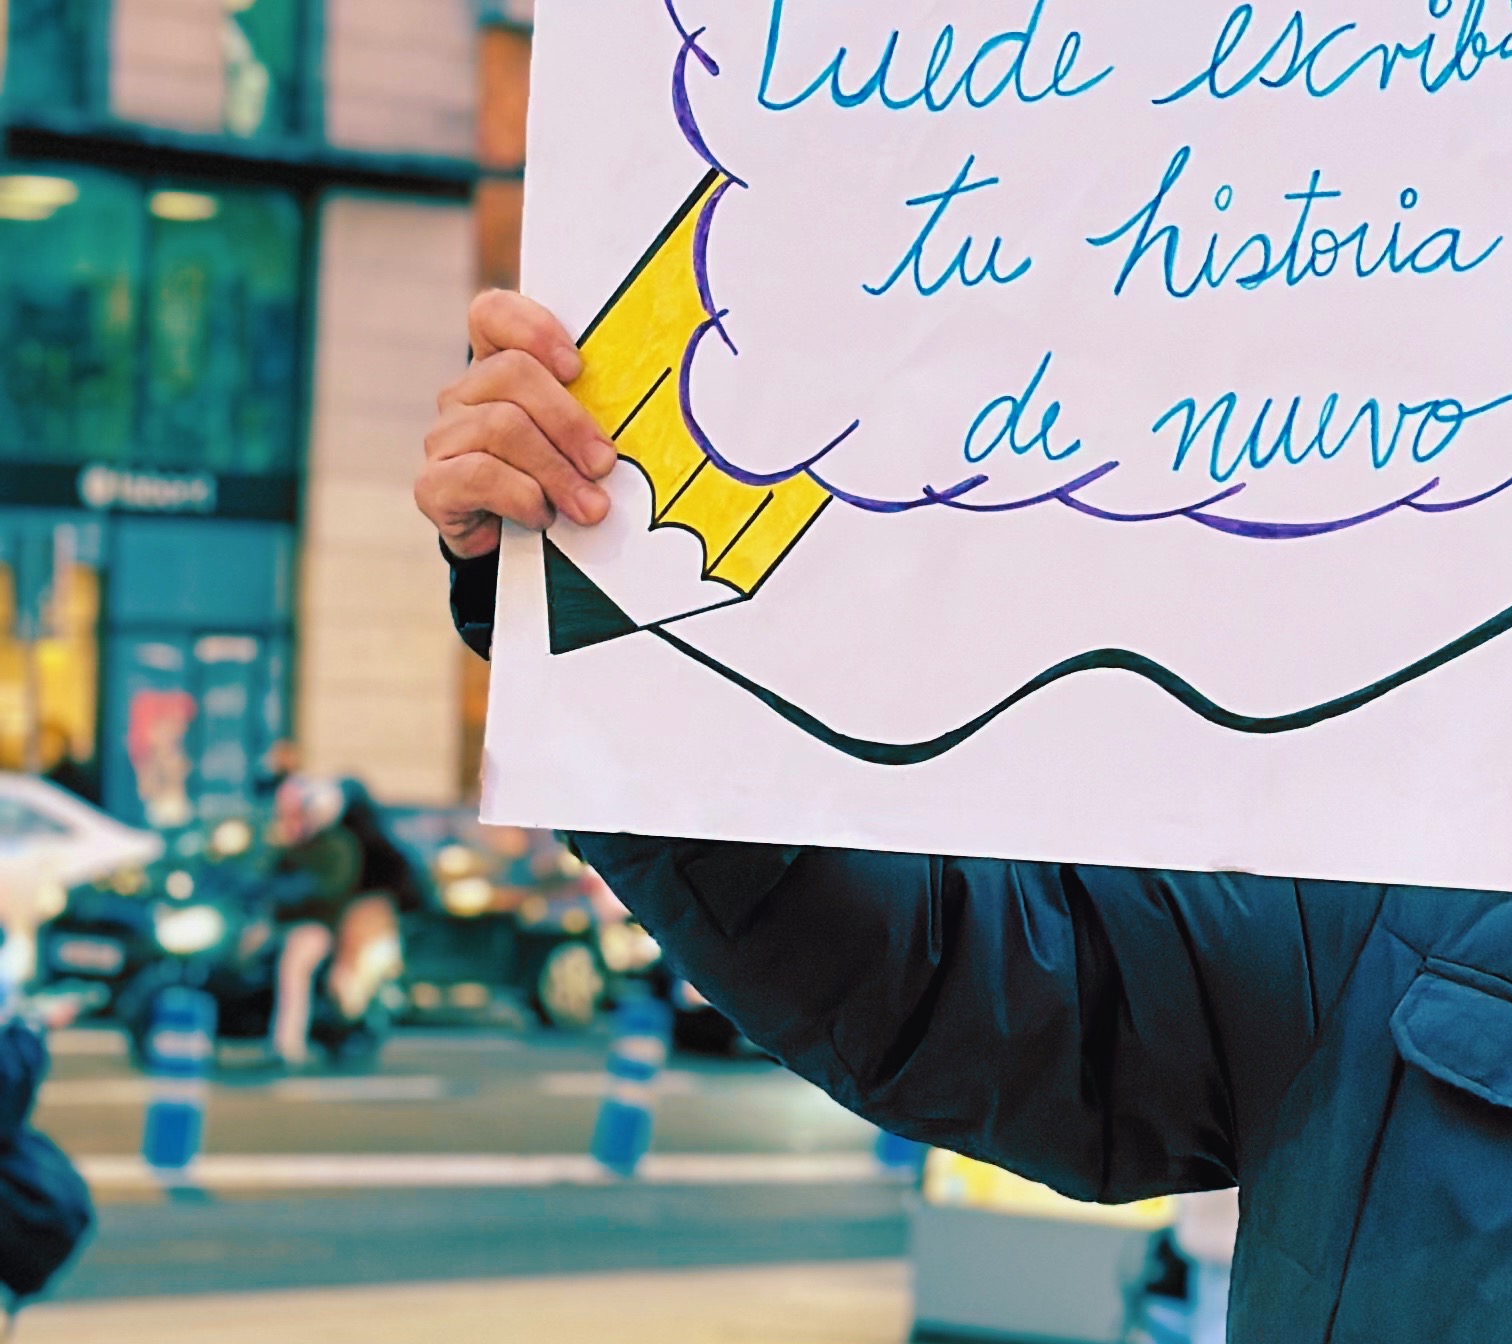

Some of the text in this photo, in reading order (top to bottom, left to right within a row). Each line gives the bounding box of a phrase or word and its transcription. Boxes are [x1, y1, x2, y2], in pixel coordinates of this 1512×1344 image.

[861, 144, 1504, 299] tu historia
[963, 351, 1082, 464] de
